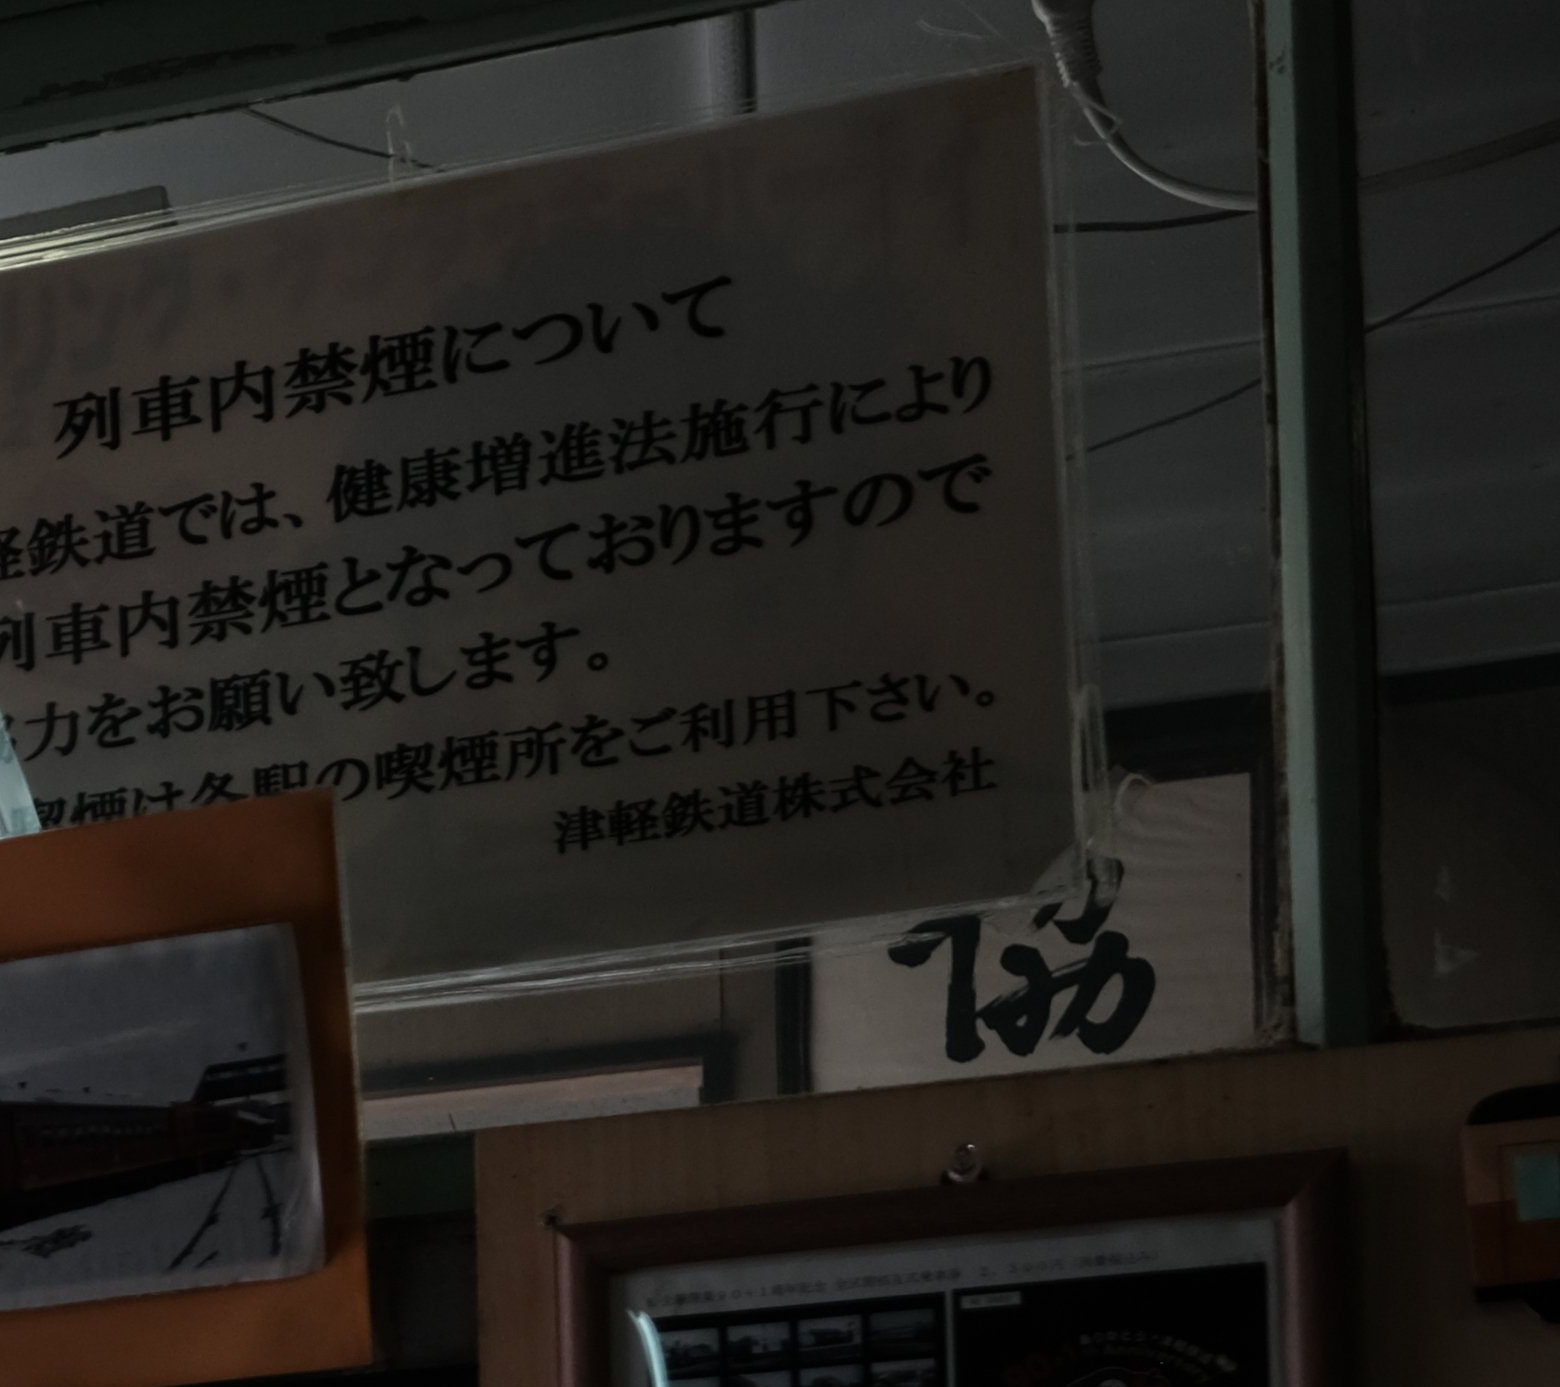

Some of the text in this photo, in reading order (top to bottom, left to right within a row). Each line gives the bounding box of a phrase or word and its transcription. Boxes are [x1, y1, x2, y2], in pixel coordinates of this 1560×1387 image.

[52, 276, 737, 460] 列車内禁煙について
[552, 745, 997, 856] 津軽鉄道株式会社
